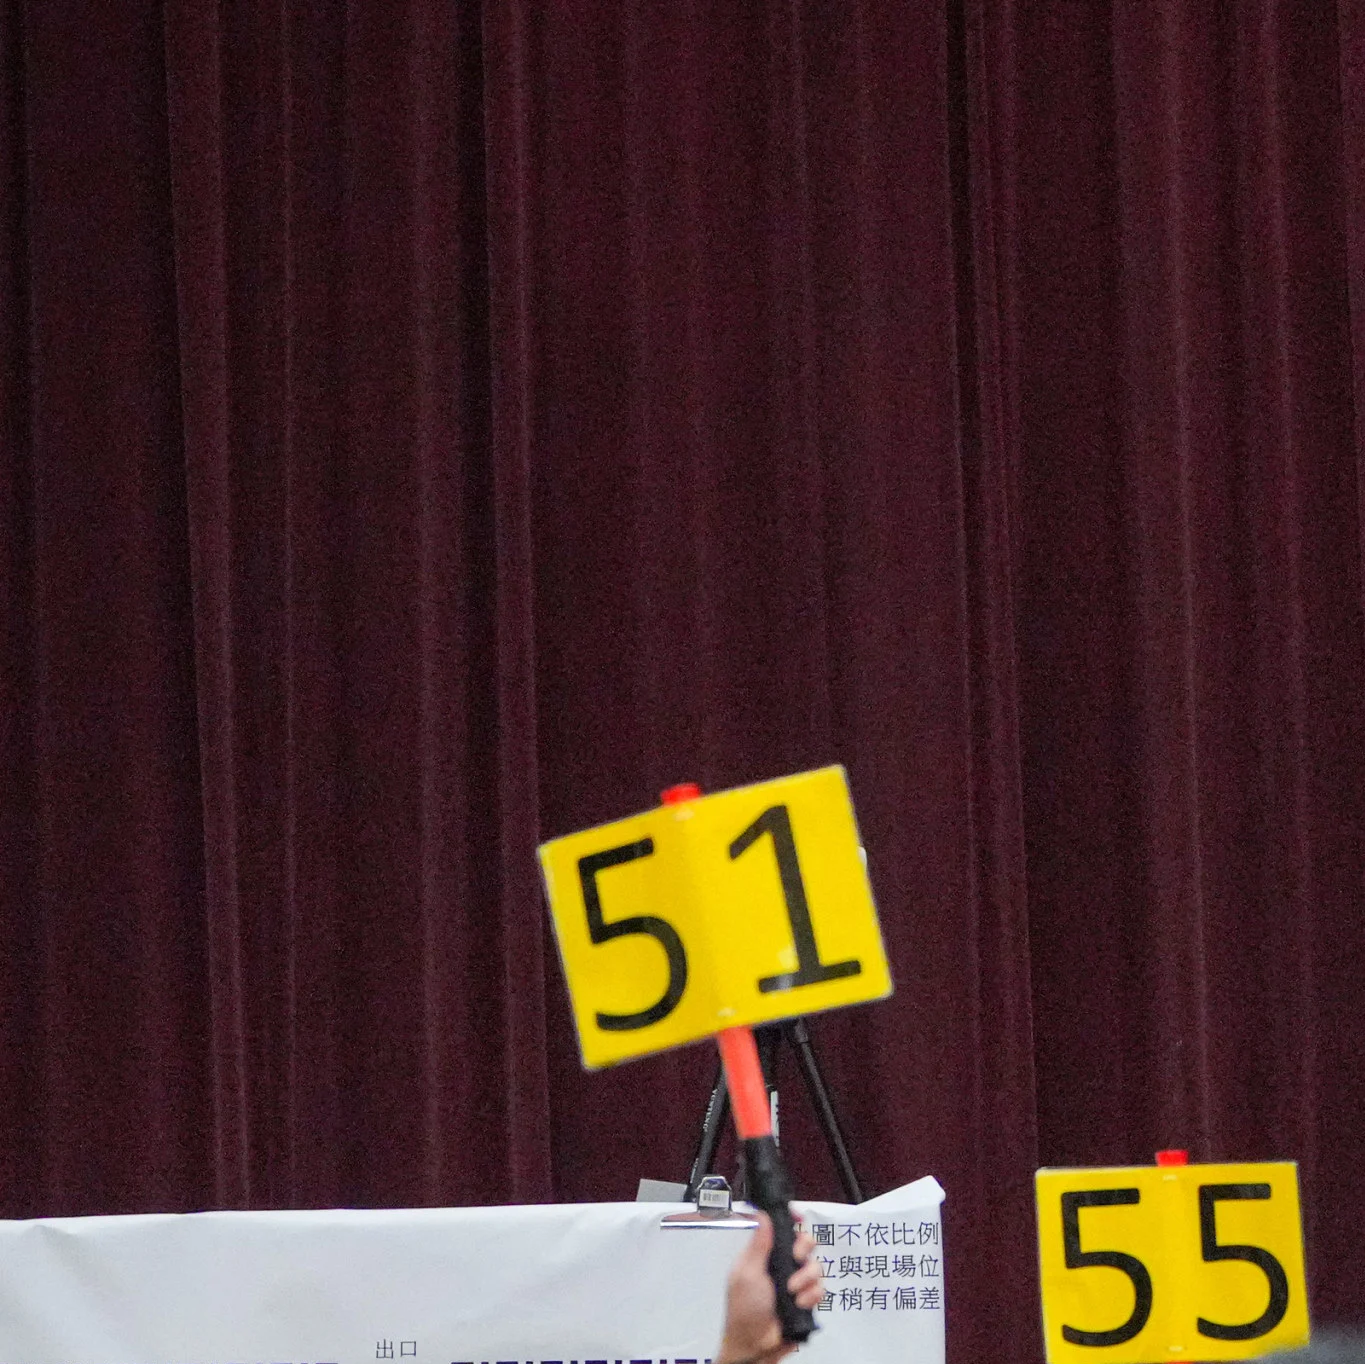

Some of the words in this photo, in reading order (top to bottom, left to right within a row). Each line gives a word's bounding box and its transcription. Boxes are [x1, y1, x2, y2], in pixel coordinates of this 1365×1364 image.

[578, 803, 862, 1031] 51
[1060, 1183, 1290, 1347] 55
[375, 1338, 417, 1359] 出口
